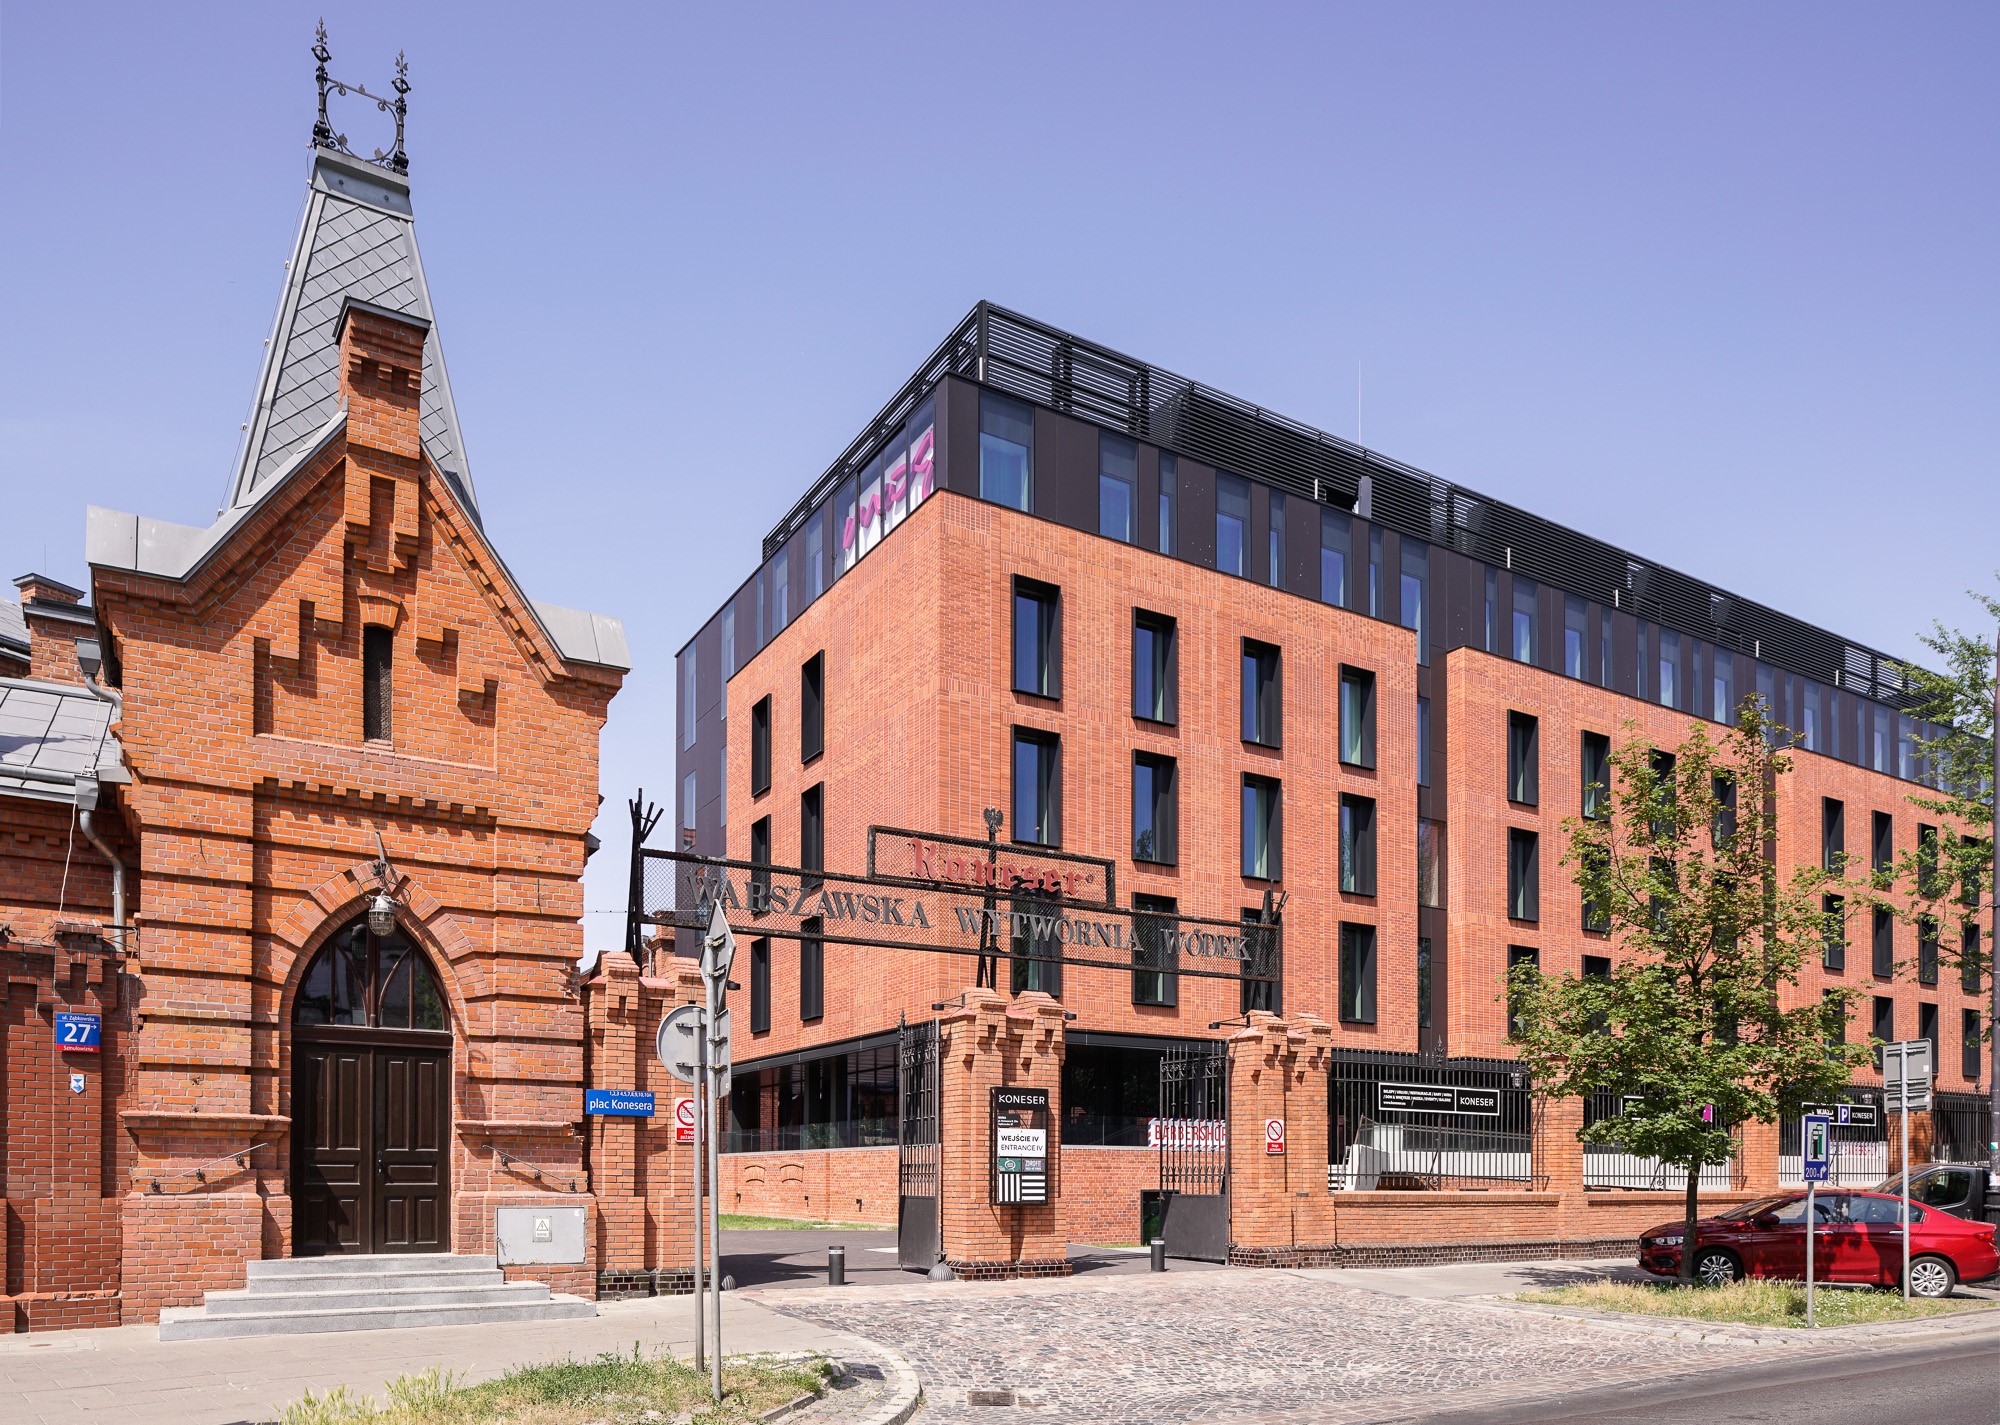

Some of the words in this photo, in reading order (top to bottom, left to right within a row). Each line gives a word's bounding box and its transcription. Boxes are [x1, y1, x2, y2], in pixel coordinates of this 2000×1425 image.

[907, 836, 1083, 896] Koneser
[686, 874, 932, 929] WARSZAWSKA
[955, 906, 1144, 951] WYTWÓRNIA
[1160, 928, 1252, 961] WÓDEK
[64, 1022, 91, 1043] 27
[589, 1098, 609, 1111] plac
[611, 1099, 653, 1111] Konesera
[998, 1094, 1045, 1105] KONESER
[1459, 1096, 1494, 1107] KONESER
[1841, 1108, 1848, 1121] P
[1001, 1134, 1030, 1142] WEJŚCIE
